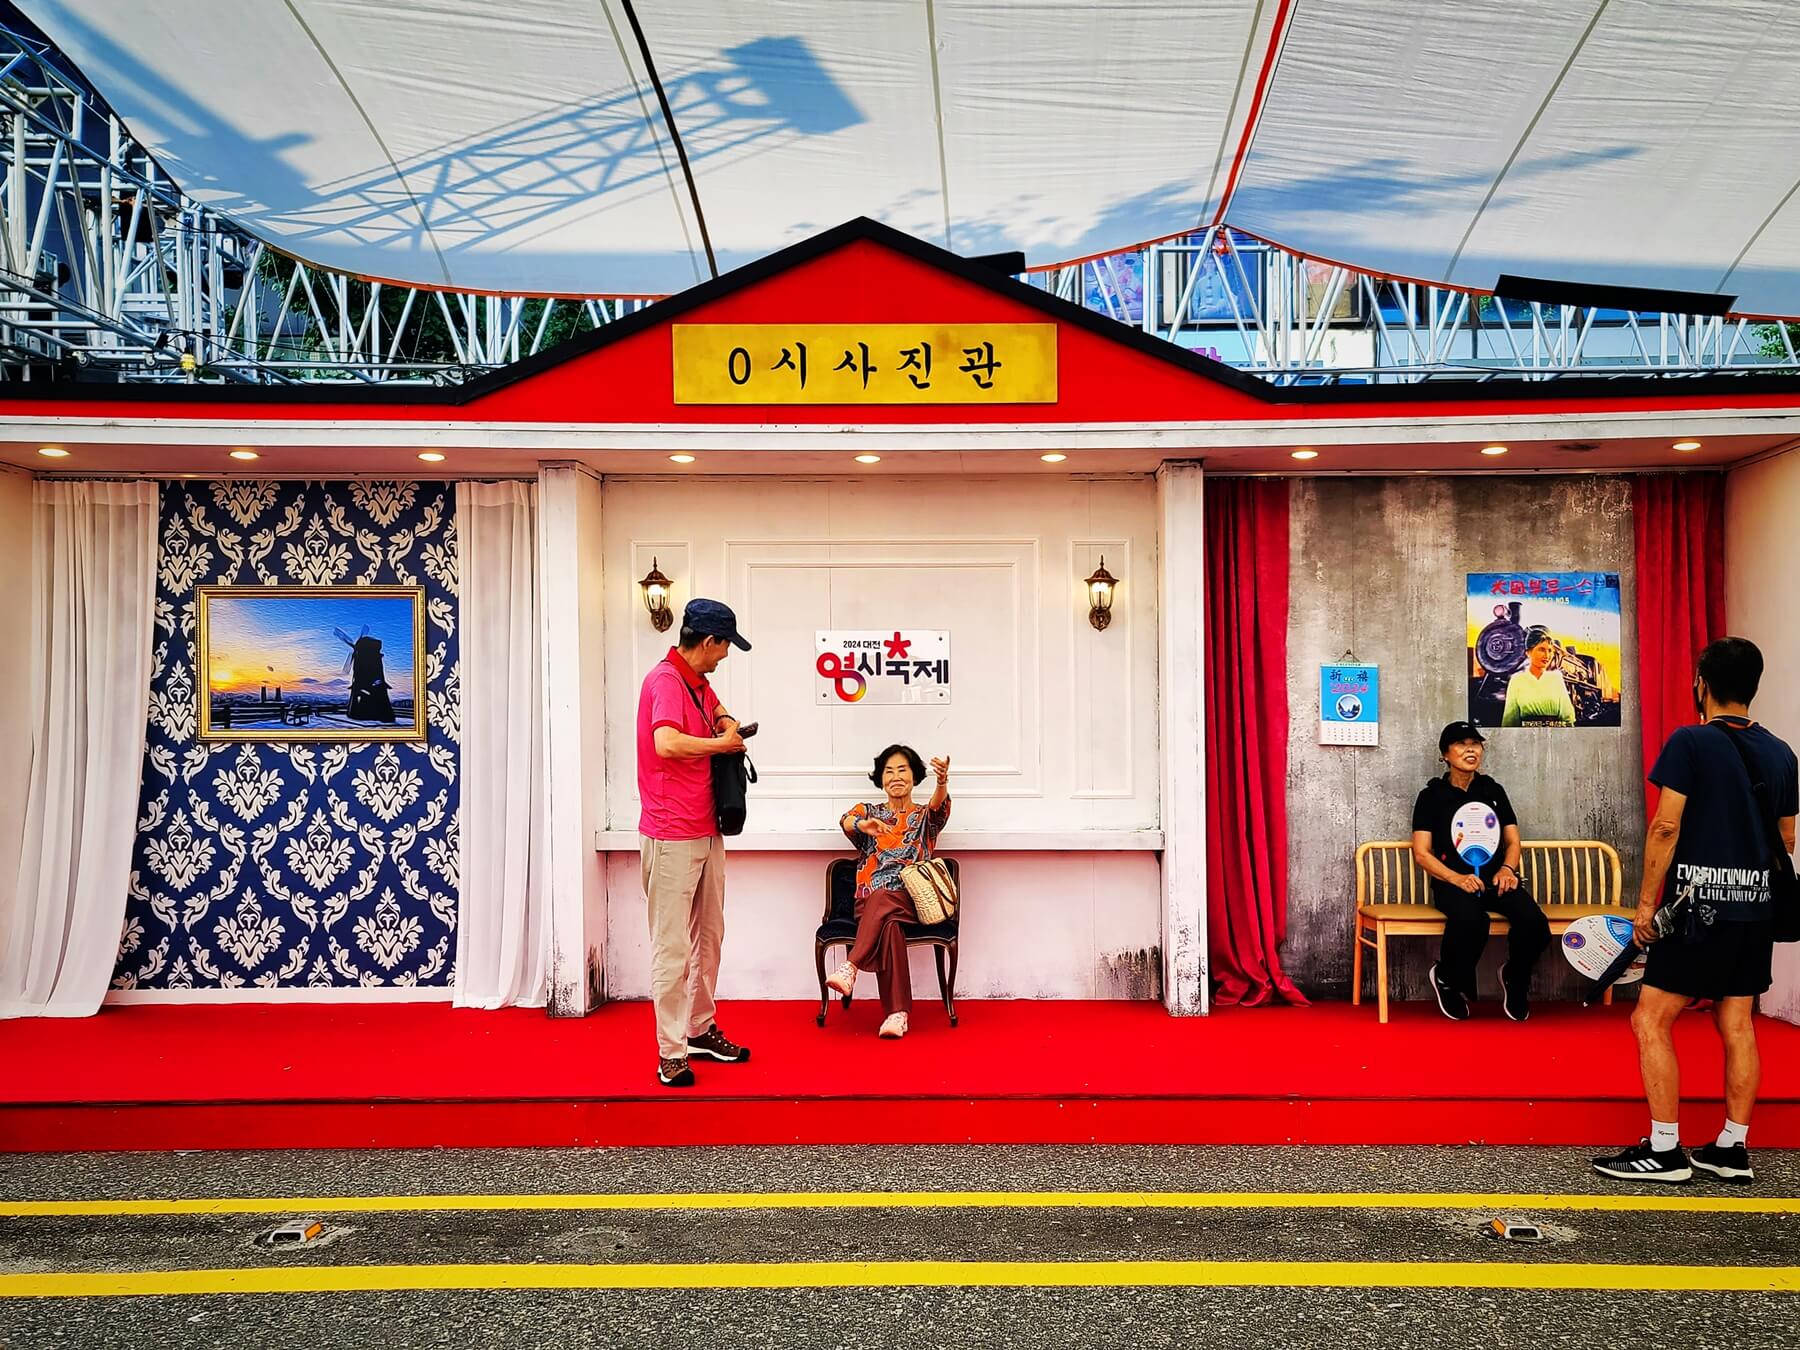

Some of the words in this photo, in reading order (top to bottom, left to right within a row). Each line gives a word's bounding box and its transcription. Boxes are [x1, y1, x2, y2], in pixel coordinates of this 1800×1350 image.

[843, 640, 861, 648] 2024
[862, 640, 881, 649] 대전
[816, 631, 949, 702] 영시축제
